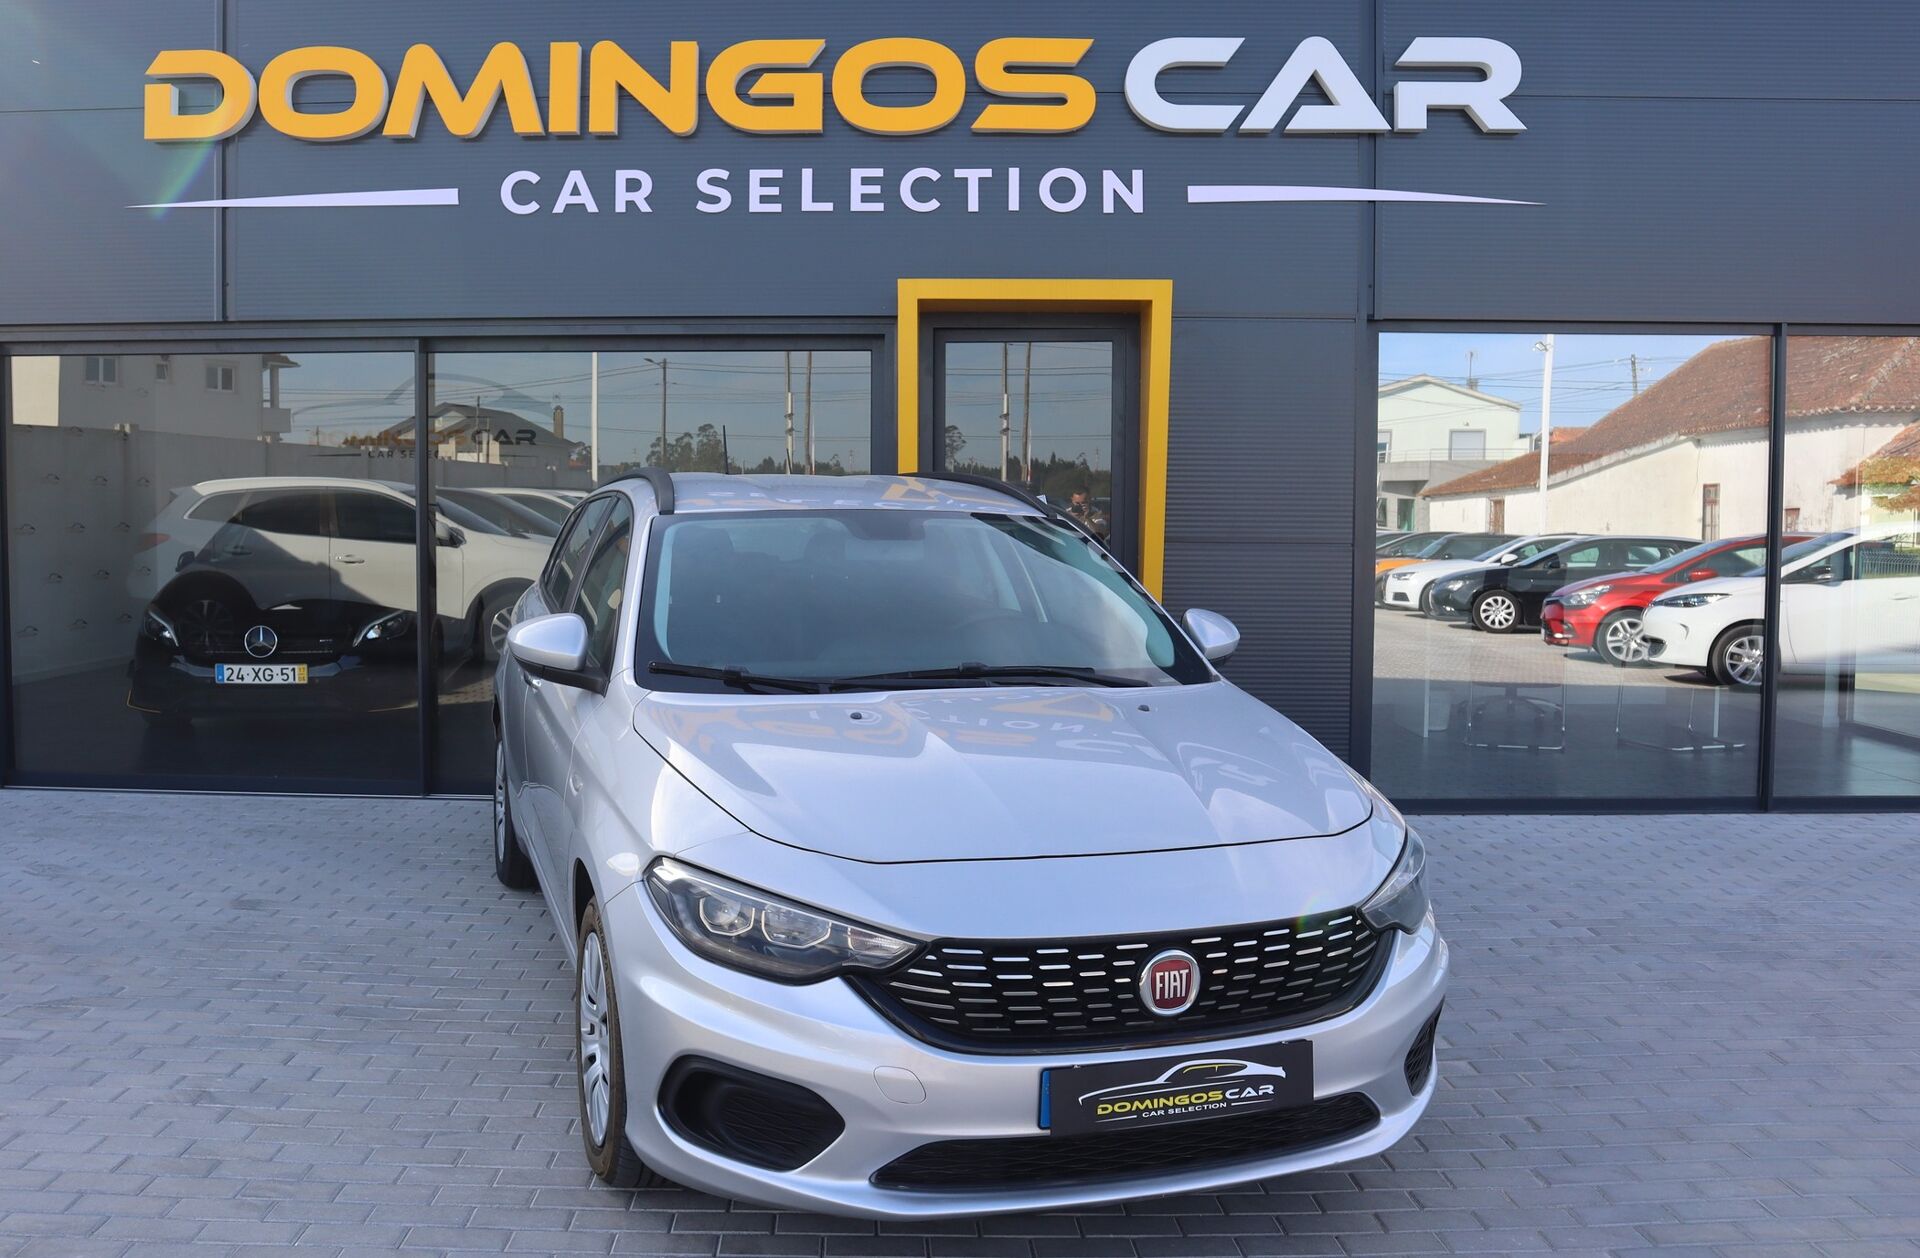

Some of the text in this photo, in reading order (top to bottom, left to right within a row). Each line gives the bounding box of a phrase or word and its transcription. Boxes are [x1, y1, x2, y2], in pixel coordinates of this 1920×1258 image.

[500, 167, 1144, 215] CAR SELECTION
[1155, 969, 1190, 1000] FIAT
[1142, 1102, 1227, 1118] CAR SELECTION
